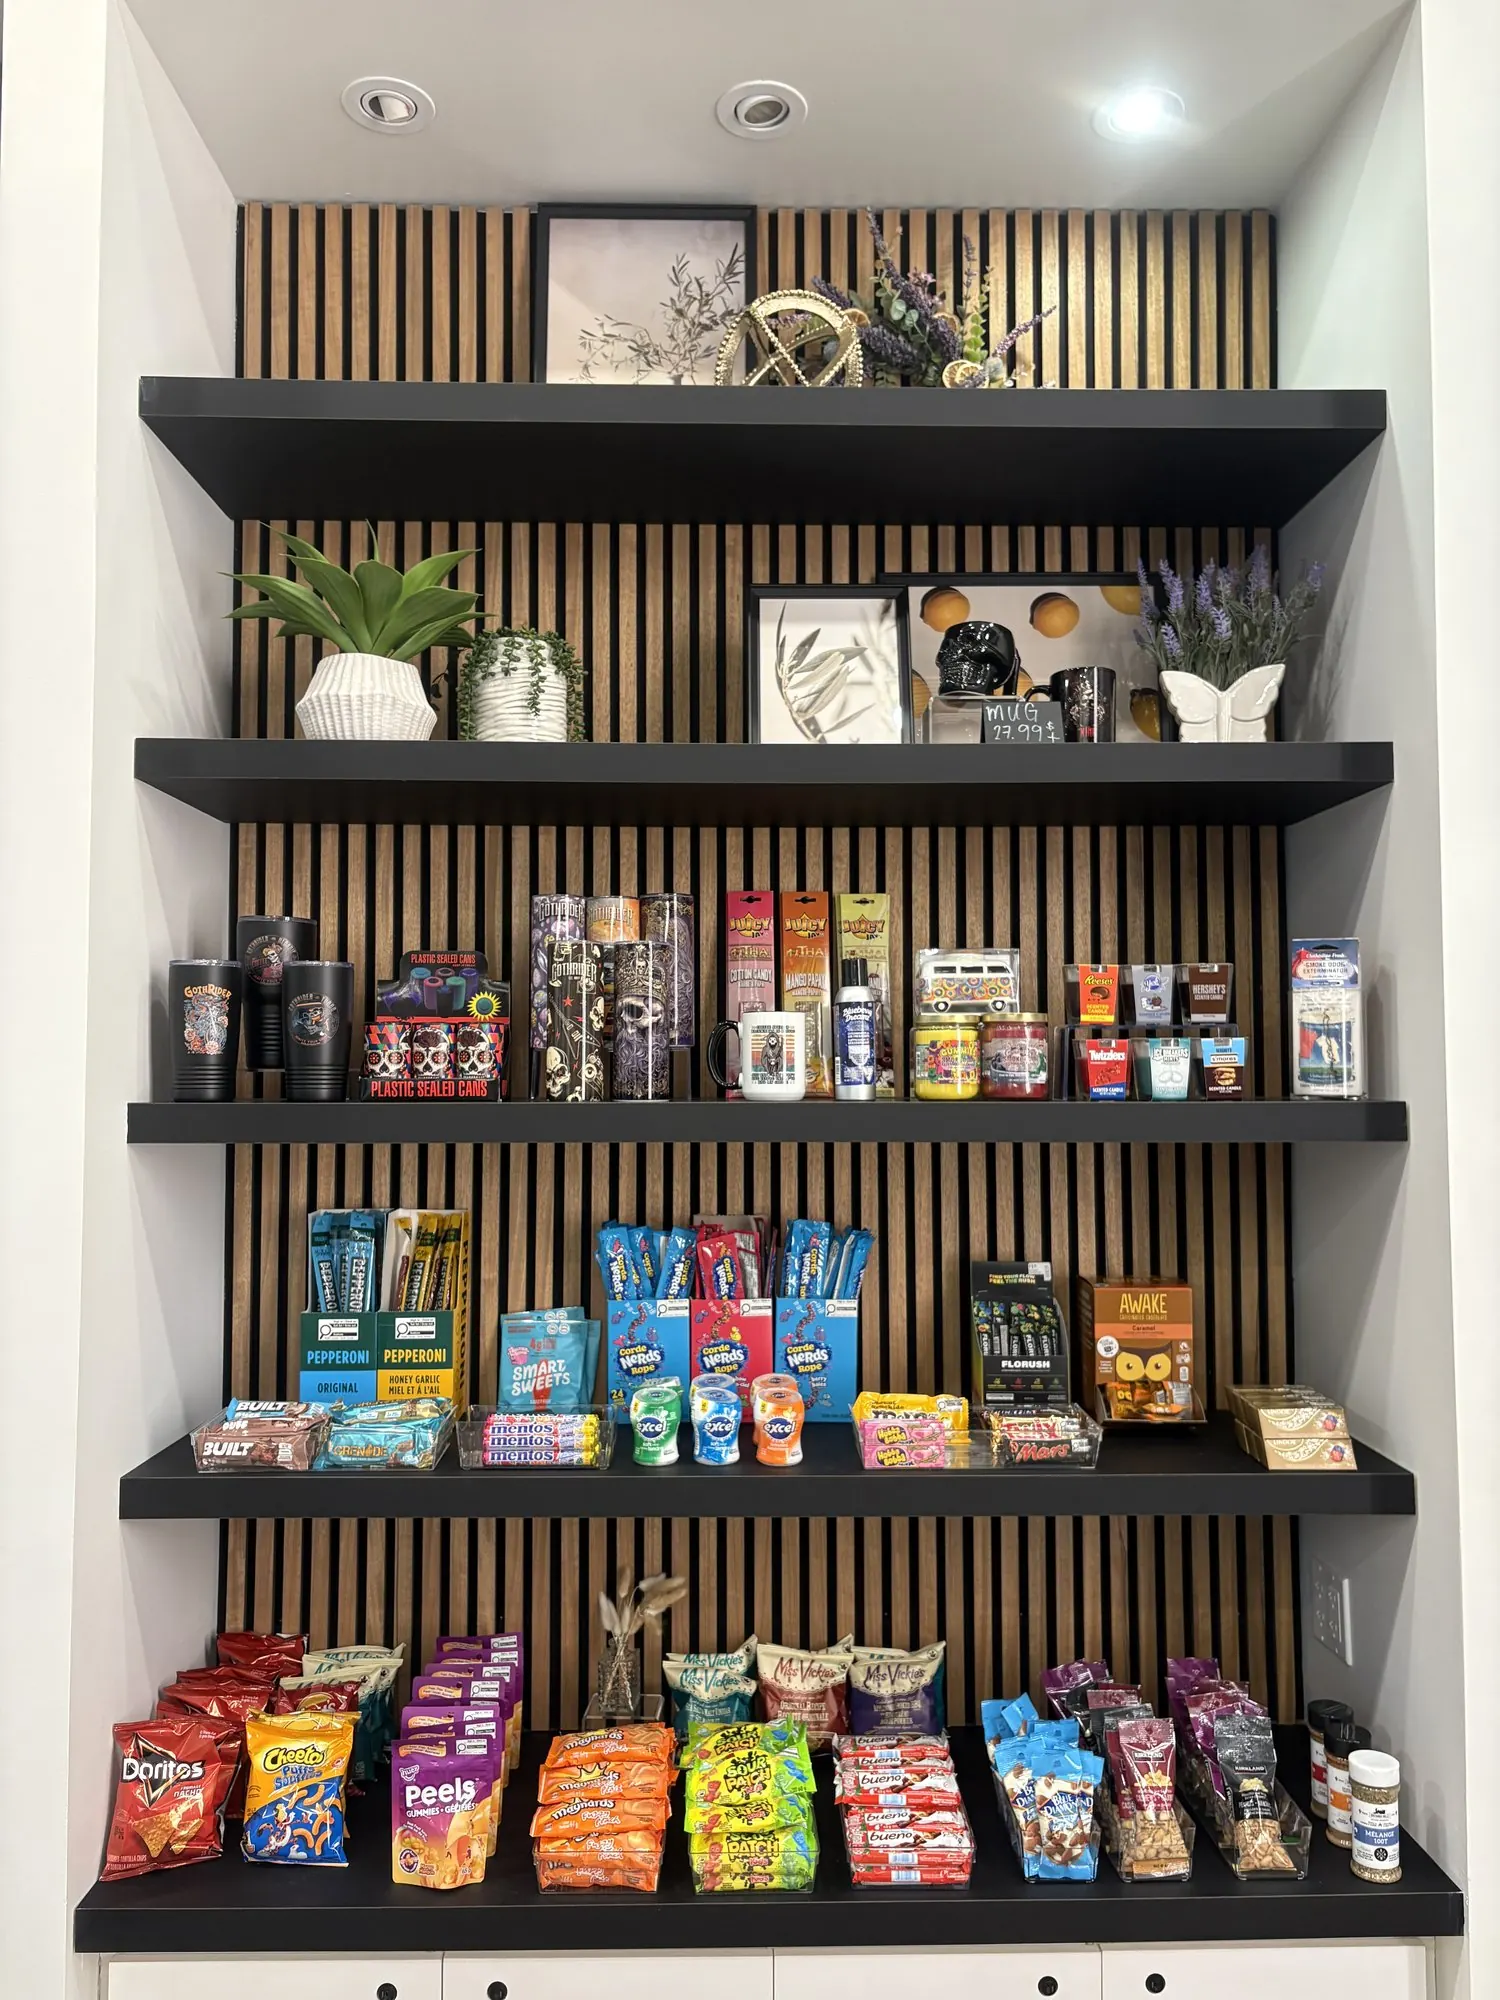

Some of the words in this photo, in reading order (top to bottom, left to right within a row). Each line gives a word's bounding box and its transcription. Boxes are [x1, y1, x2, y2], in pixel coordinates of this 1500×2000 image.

[986, 702, 1039, 722] MUG
[730, 917, 772, 932] JUICY
[785, 917, 827, 932] JUICY
[843, 919, 885, 934] JUICY
[410, 953, 436, 964] PLASTIC
[437, 953, 458, 964] SEALED
[459, 953, 476, 964] CANS
[552, 962, 597, 981] GOTHRIDER
[184, 983, 232, 999] GOTHRIDER
[1192, 984, 1226, 994] HERSHEY'S
[1089, 1049, 1126, 1061] Twizzlers
[371, 1081, 414, 1097] PLASTIC
[417, 1081, 455, 1097] SEALED
[458, 1080, 488, 1097] CANS
[318, 1261, 338, 1312] PEPPERO
[350, 1257, 368, 1312] PEPPERO
[404, 1261, 424, 1312] PEPPERO
[1120, 1293, 1168, 1314] AWAKE
[383, 1348, 447, 1363] PEPPERONI
[619, 1344, 647, 1357] Corde
[702, 1343, 730, 1356] Corde
[786, 1343, 815, 1354] Corde
[307, 1350, 369, 1364] PEPPERONI
[1001, 1360, 1050, 1368] FLORUSH
[512, 1360, 567, 1381] SMART
[630, 1363, 656, 1375] Rope
[714, 1363, 739, 1374] Rope
[797, 1363, 823, 1374] Rope
[389, 1375, 413, 1384] HONEY
[415, 1374, 440, 1384] GARLIC
[511, 1372, 571, 1396] SWEETS
[317, 1382, 358, 1393] ORIGINAL
[389, 1385, 405, 1394] MIEL
[407, 1385, 415, 1394] ET
[424, 1384, 440, 1393] L'AIL
[611, 1389, 624, 1399] 24
[235, 1402, 287, 1411] BUILT
[490, 1423, 553, 1434] mentos
[636, 1420, 667, 1433] excel
[703, 1420, 735, 1433] excel
[763, 1420, 796, 1433] excel
[490, 1435, 554, 1447] mentos
[203, 1442, 254, 1456] BUILT
[490, 1450, 553, 1462] mentos
[1016, 1442, 1070, 1463] Mars
[773, 1656, 799, 1682] Miss
[799, 1659, 836, 1683] Vickie's
[863, 1664, 887, 1689] Miss
[888, 1663, 925, 1685] Vickie's
[680, 1669, 703, 1688] Miss
[704, 1668, 740, 1693] Vickie's
[564, 1731, 625, 1751] maynards
[857, 1736, 897, 1745] bueno
[264, 1746, 325, 1771] Cheeto
[860, 1757, 900, 1765] bueno
[123, 1758, 205, 1780] Doritos
[727, 1757, 767, 1778] SOUR
[724, 1767, 772, 1792] PATCH
[861, 1774, 902, 1785] bueno
[405, 1777, 476, 1808] Peels
[406, 1806, 440, 1818] GUMMIES
[552, 1799, 615, 1820] maynards
[866, 1812, 908, 1822] bueno
[870, 1831, 912, 1842] bueno
[728, 1841, 780, 1859] PATCH
